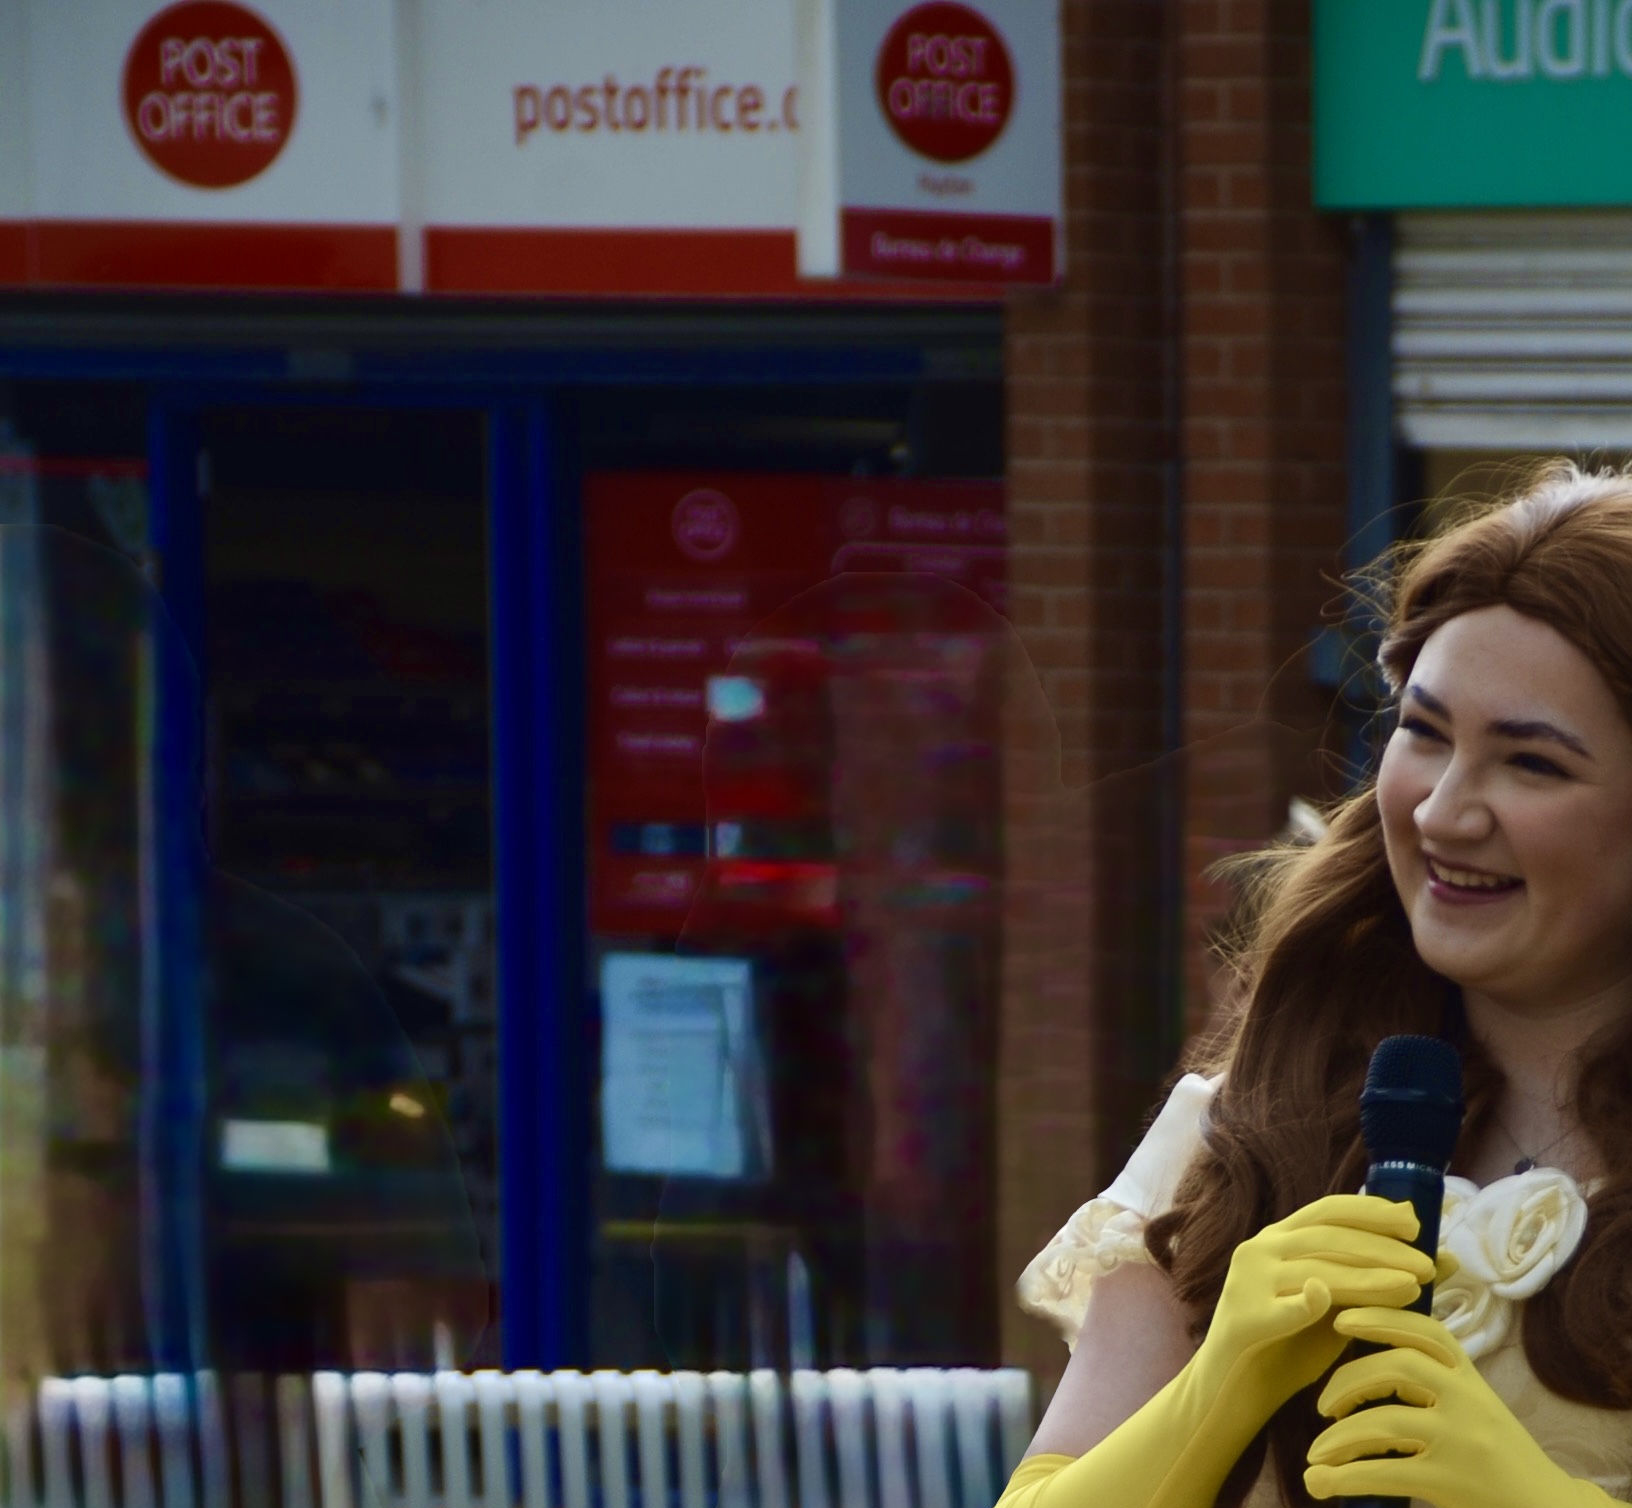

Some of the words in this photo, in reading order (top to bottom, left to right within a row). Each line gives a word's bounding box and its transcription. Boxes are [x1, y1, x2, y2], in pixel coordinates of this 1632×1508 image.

[161, 37, 263, 87] POST
[908, 34, 988, 76] POST
[138, 91, 280, 142] OFFICE
[889, 78, 1000, 124] OFFICE
